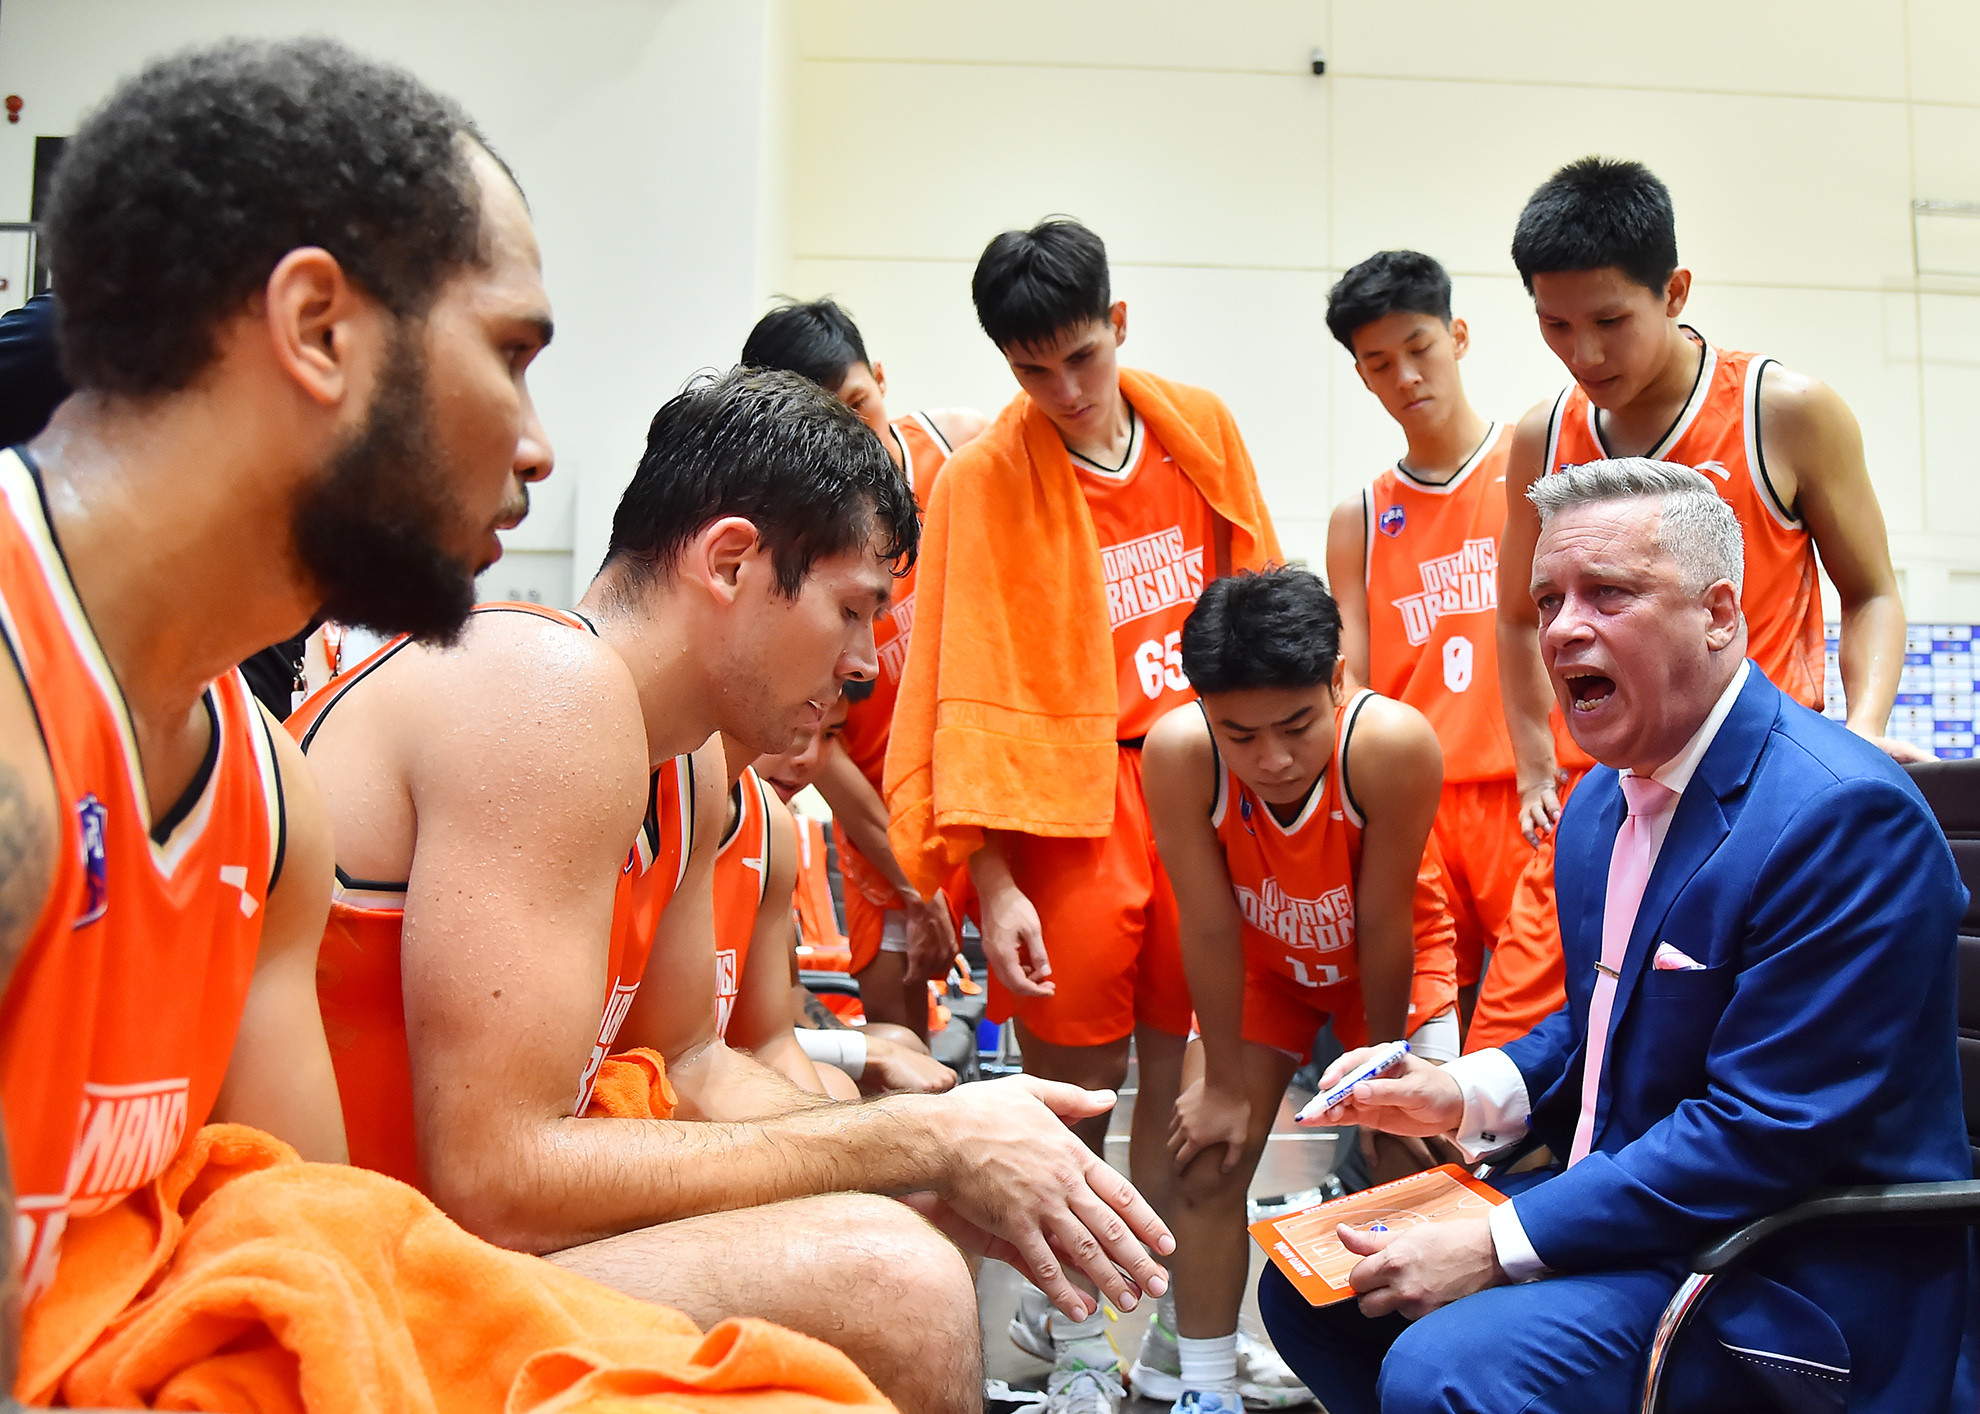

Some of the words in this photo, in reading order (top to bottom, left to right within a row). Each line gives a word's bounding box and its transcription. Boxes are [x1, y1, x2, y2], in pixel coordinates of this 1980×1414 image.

[1105, 551, 1203, 625] RAGONS
[1133, 630, 1191, 700] 65
[1442, 635, 1474, 694] 0
[1238, 889, 1354, 951] DRAGON
[1285, 955, 1348, 988] 11
